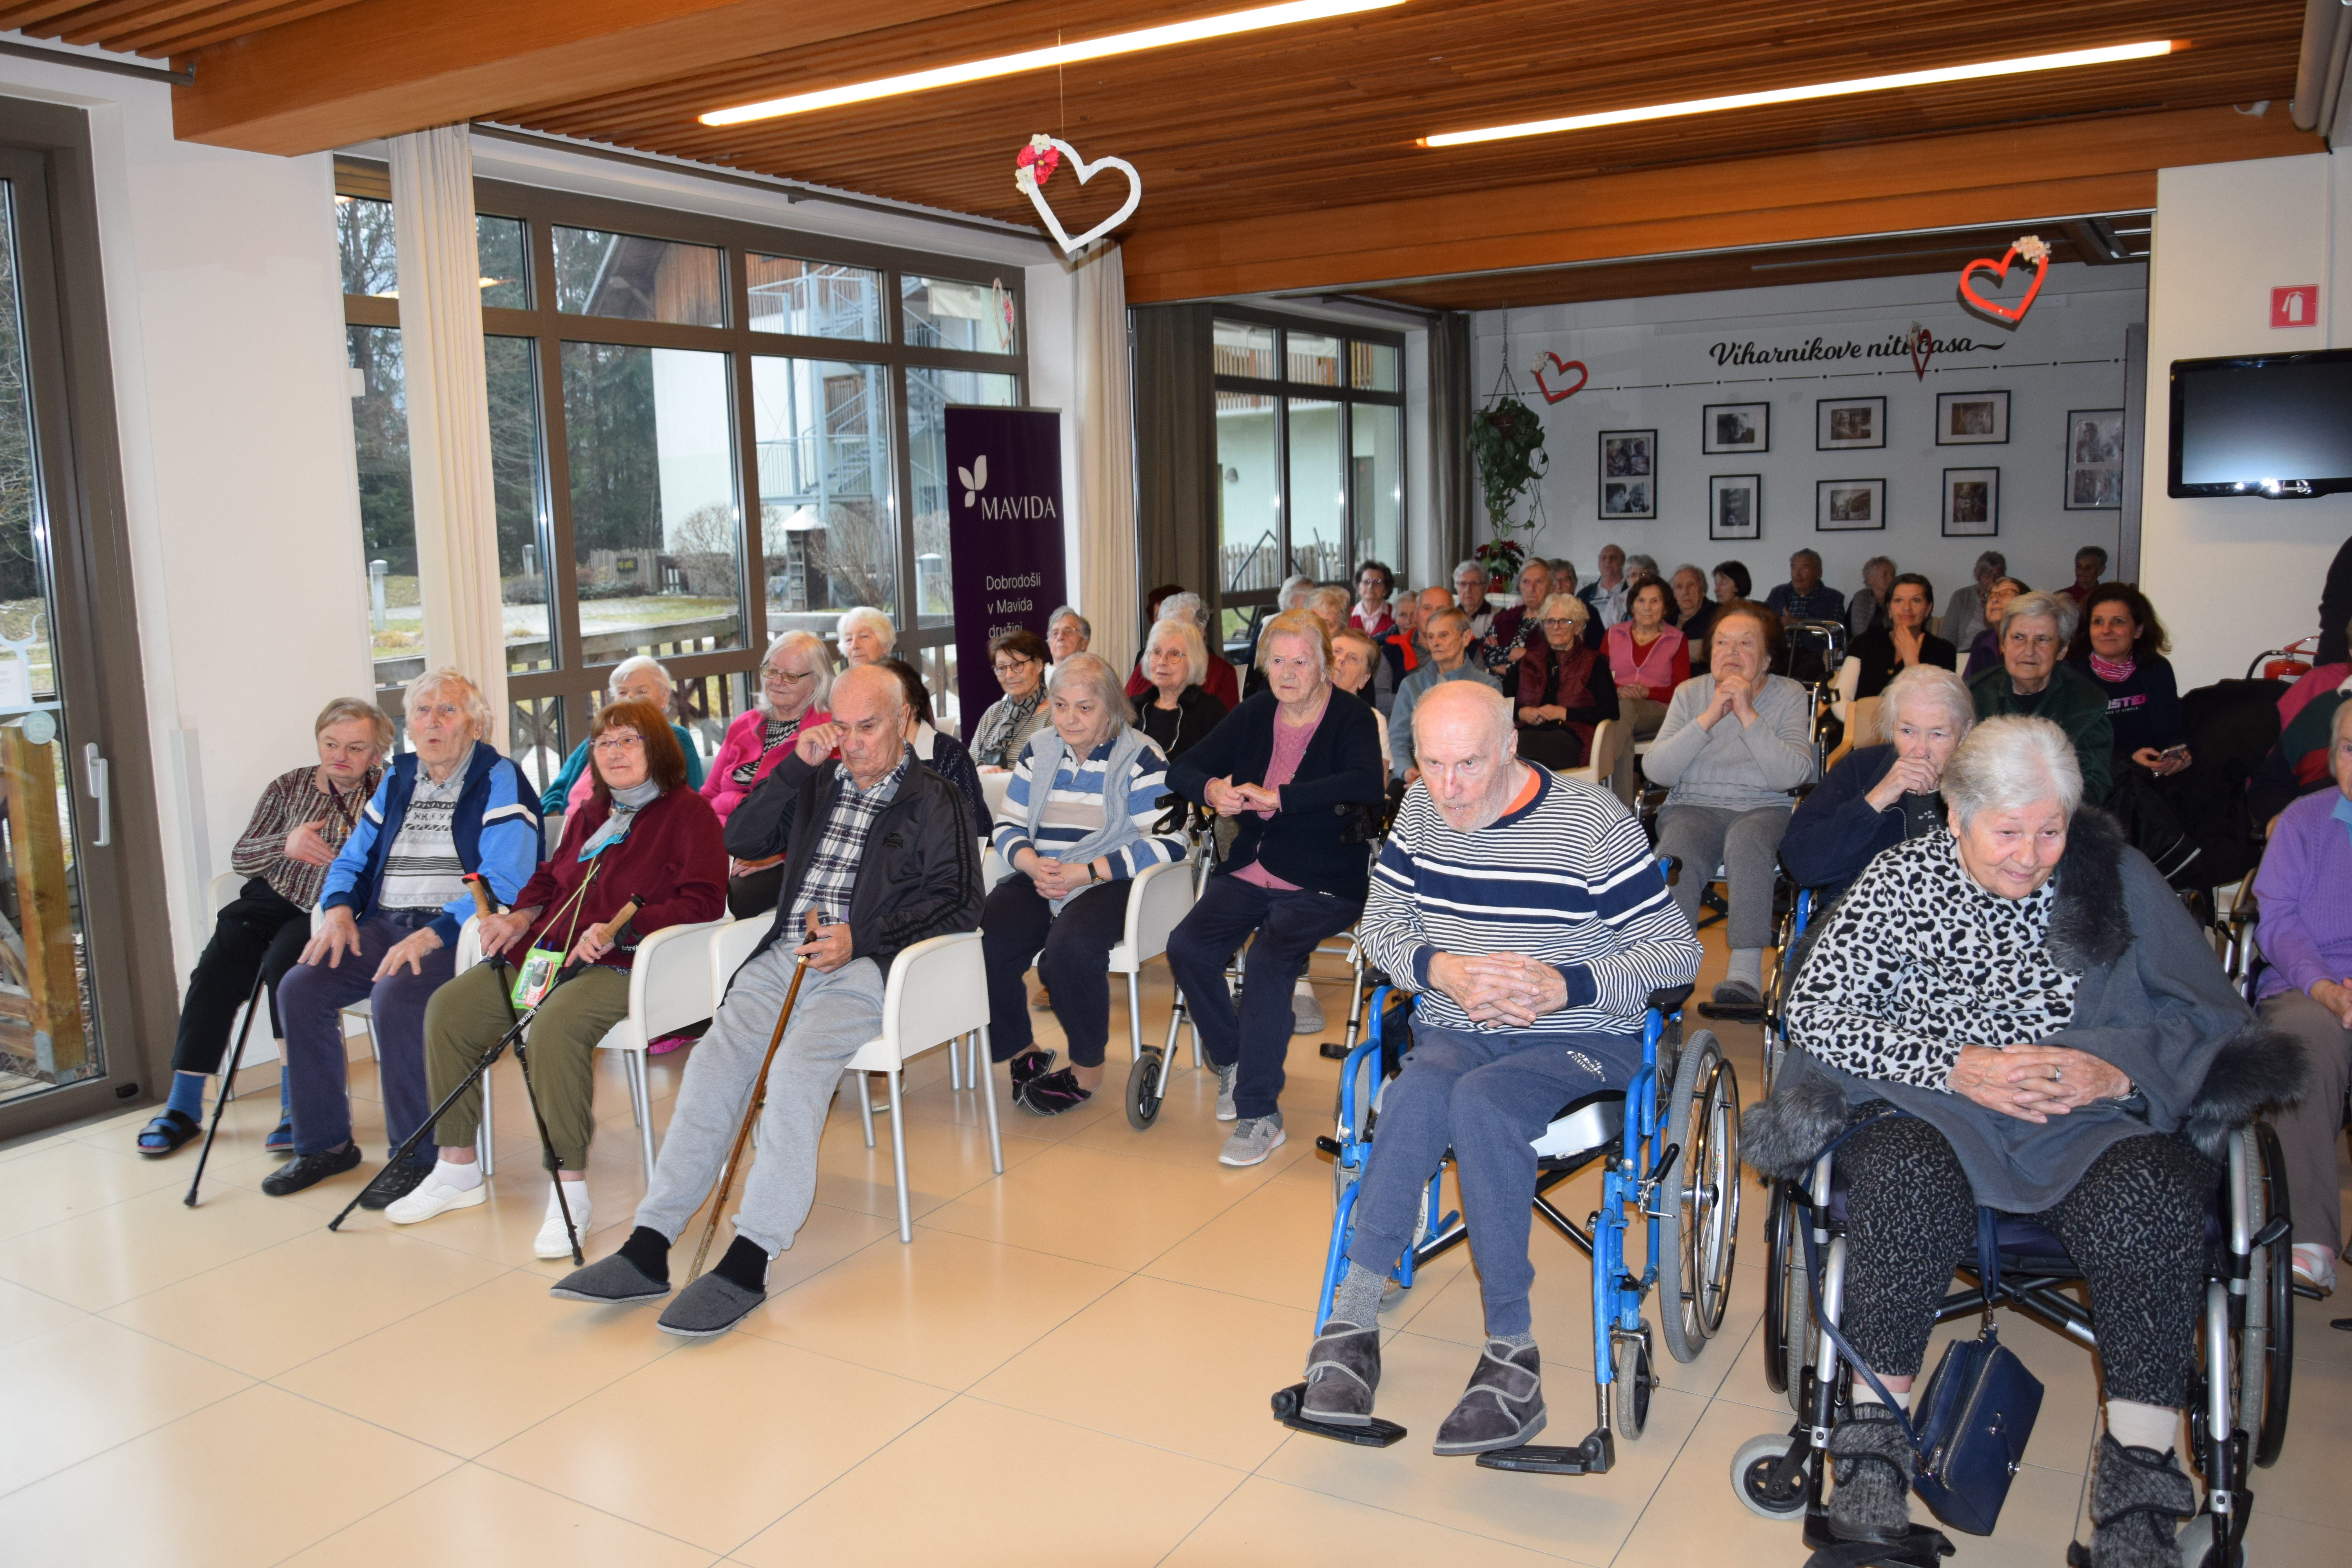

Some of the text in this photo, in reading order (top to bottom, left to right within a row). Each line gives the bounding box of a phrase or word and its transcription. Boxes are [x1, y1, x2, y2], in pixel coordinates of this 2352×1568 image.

[1710, 337, 1862, 366] Viharnikove
[1867, 335, 1910, 358] niti
[982, 496, 1056, 520] MAVIDA
[987, 572, 1040, 590] Dobrodošli
[988, 597, 1032, 614] v Mavida
[519, 1008, 536, 1026] Entrek
